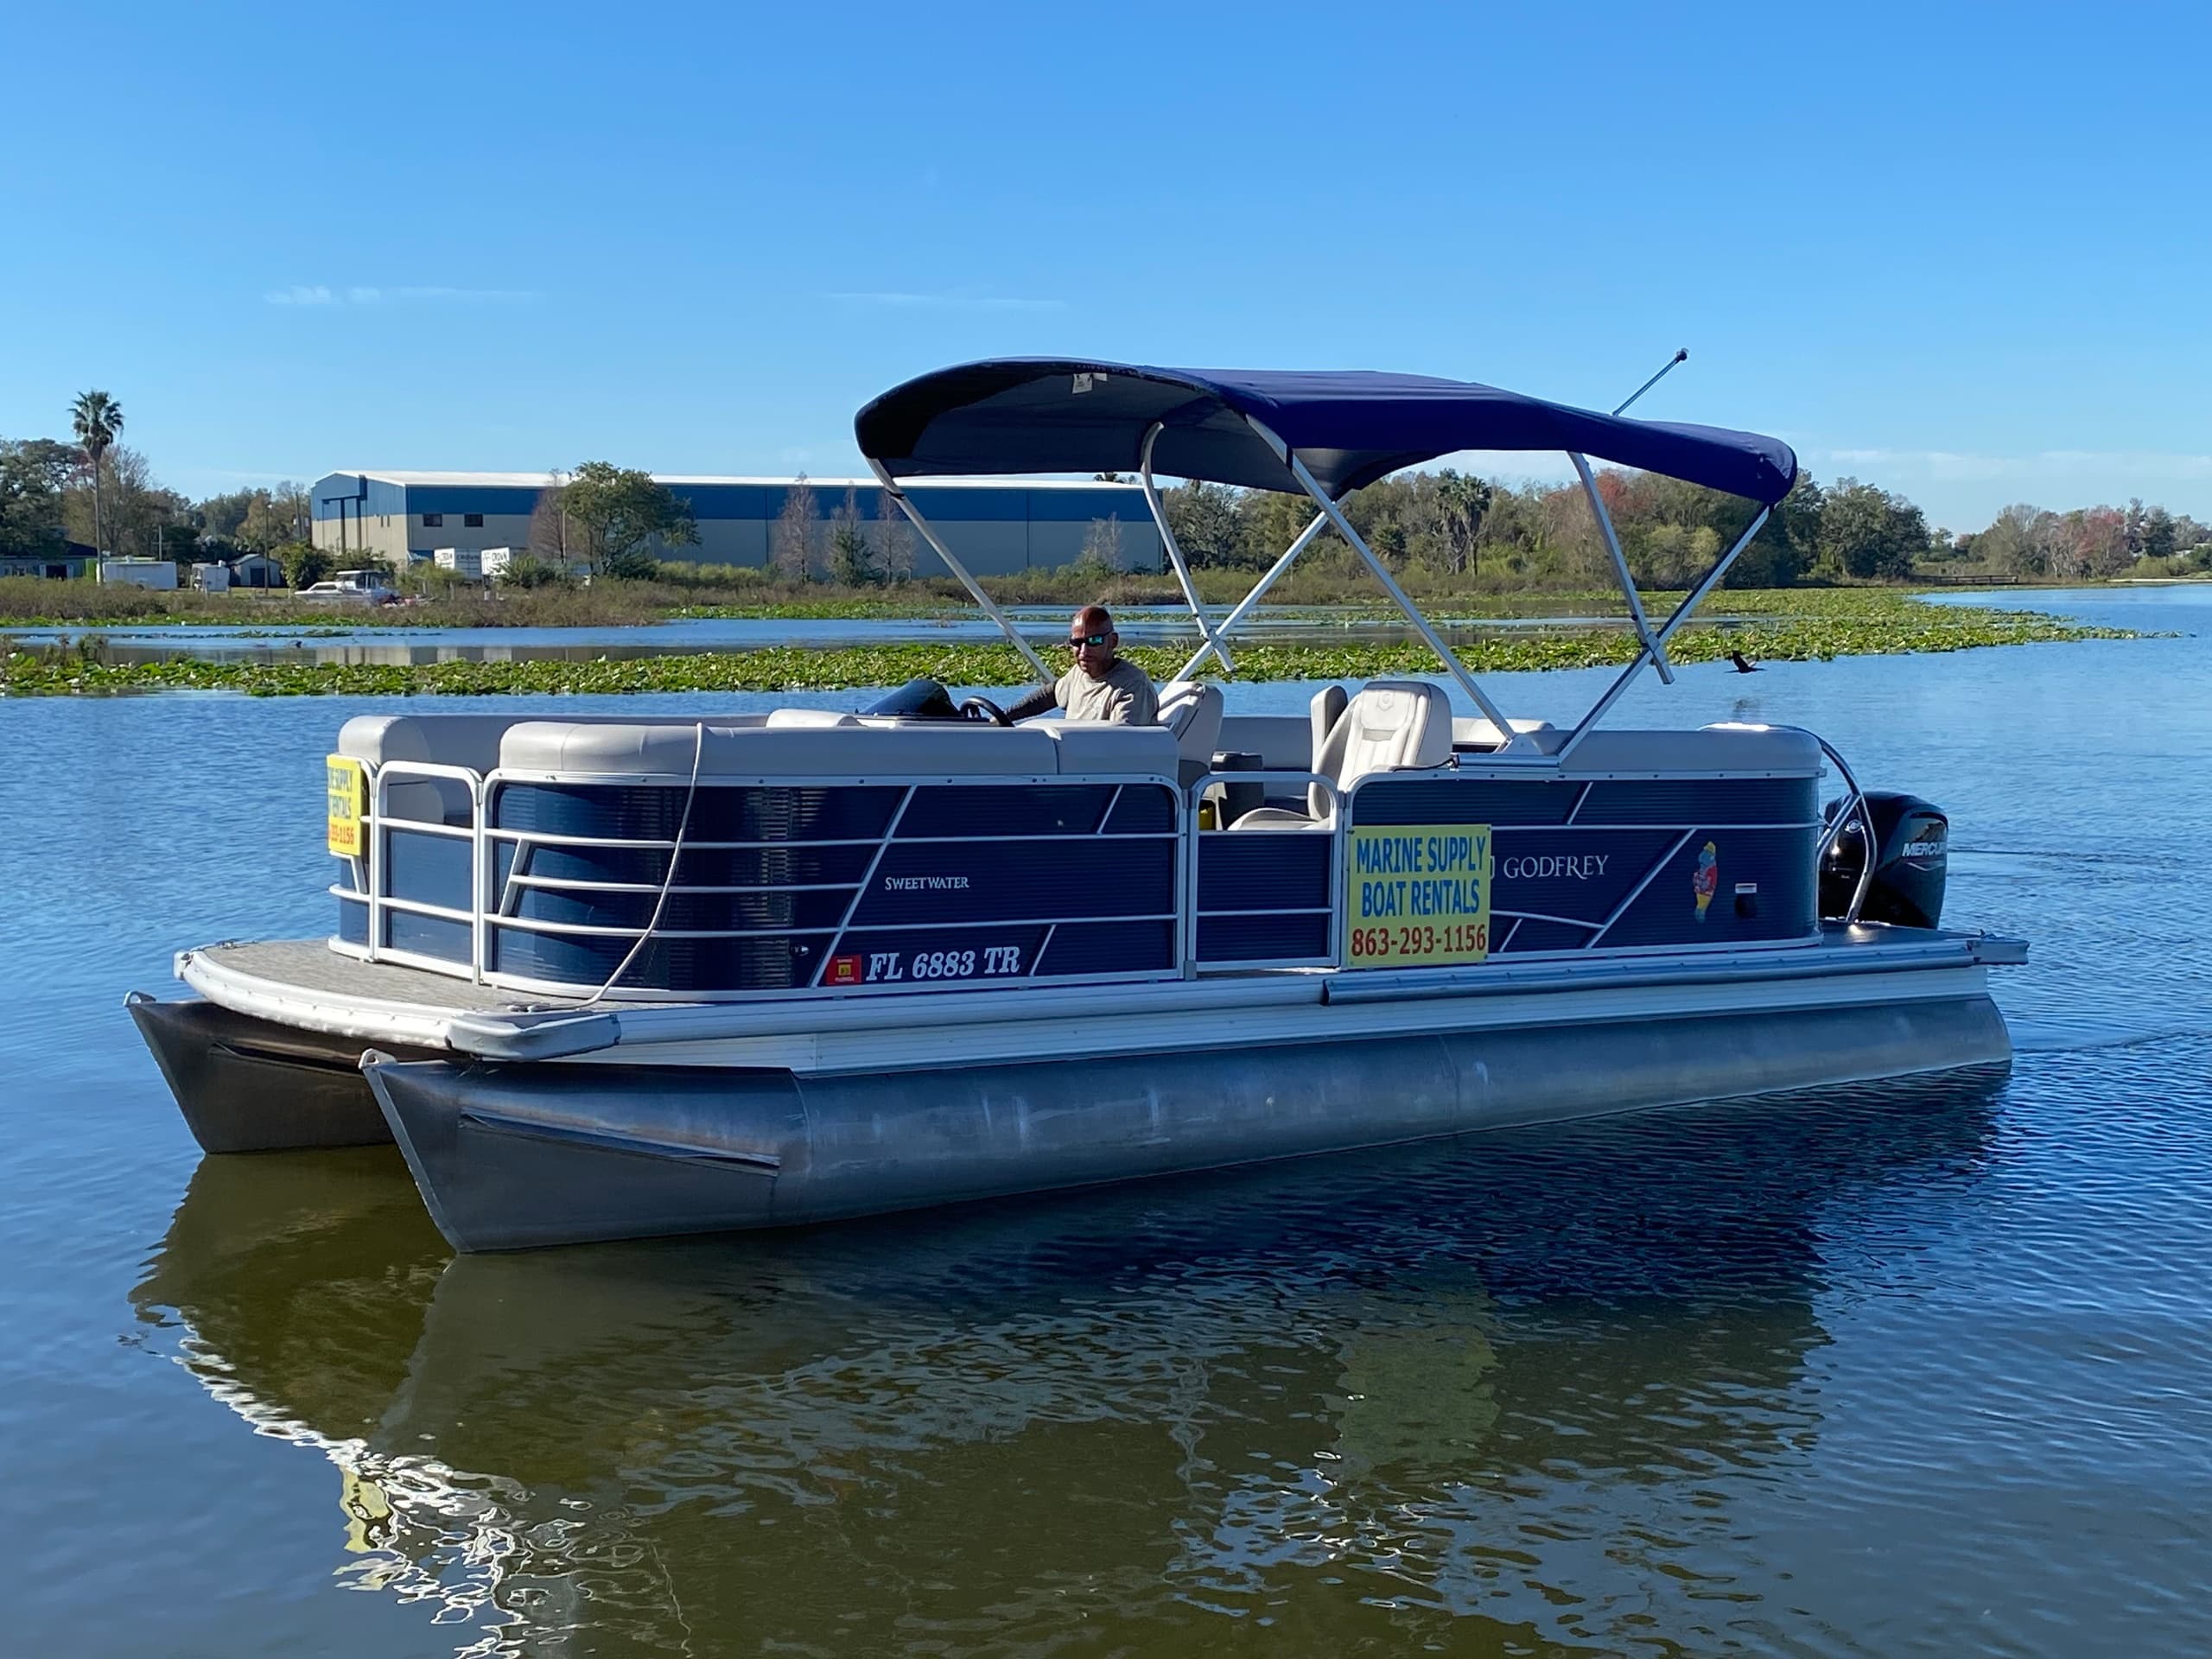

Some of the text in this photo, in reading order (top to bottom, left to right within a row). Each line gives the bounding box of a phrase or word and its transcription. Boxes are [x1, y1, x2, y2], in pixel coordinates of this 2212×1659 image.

[1357, 836, 1486, 874] MARINE SUPPLY
[1902, 842, 1945, 857] MERCU
[885, 876, 969, 891] SWEETWATER
[1503, 855, 1609, 880] GODFREY
[1362, 879, 1480, 918] BOAT RENTALS
[1351, 924, 1486, 957] 863-293-1156
[865, 946, 1020, 982] FL 6883 TR
